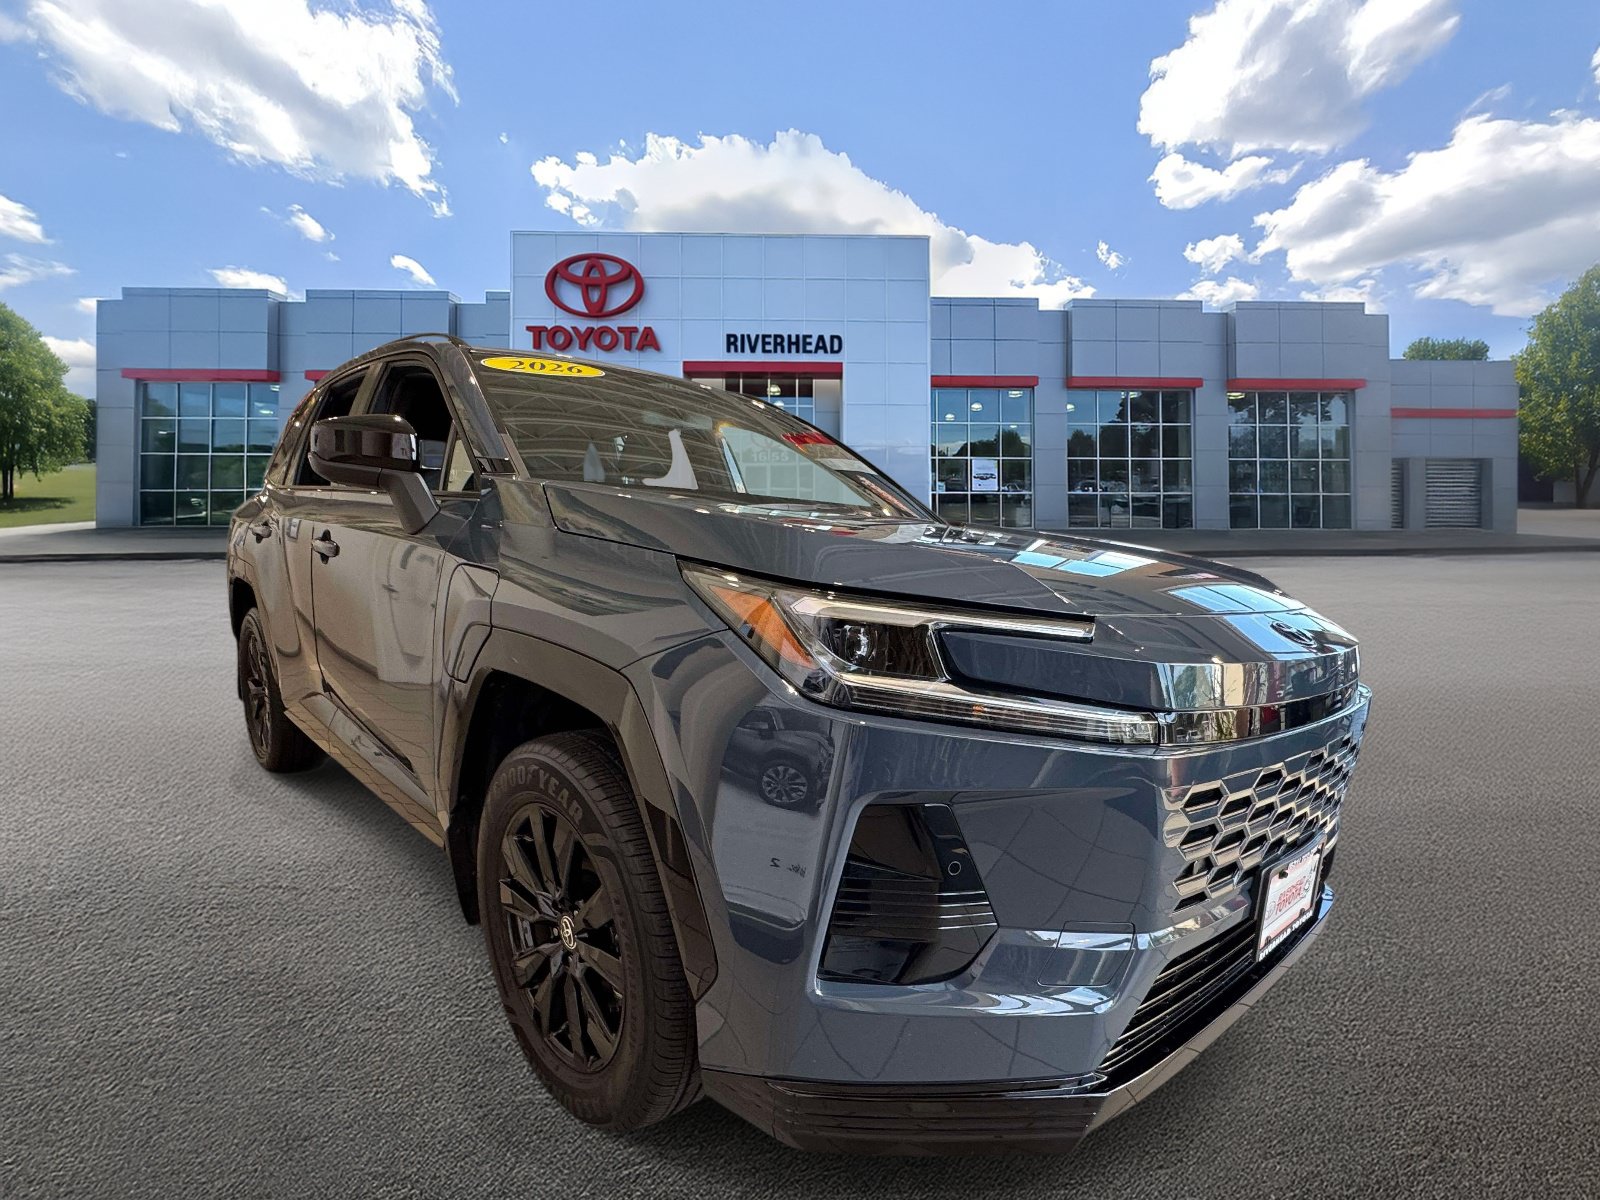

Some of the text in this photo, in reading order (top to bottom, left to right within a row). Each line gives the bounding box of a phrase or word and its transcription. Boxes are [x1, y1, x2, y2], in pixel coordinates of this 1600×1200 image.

[526, 326, 661, 351] TOYOTA
[726, 334, 843, 354] RIVERHEAD
[510, 360, 583, 373] 2026
